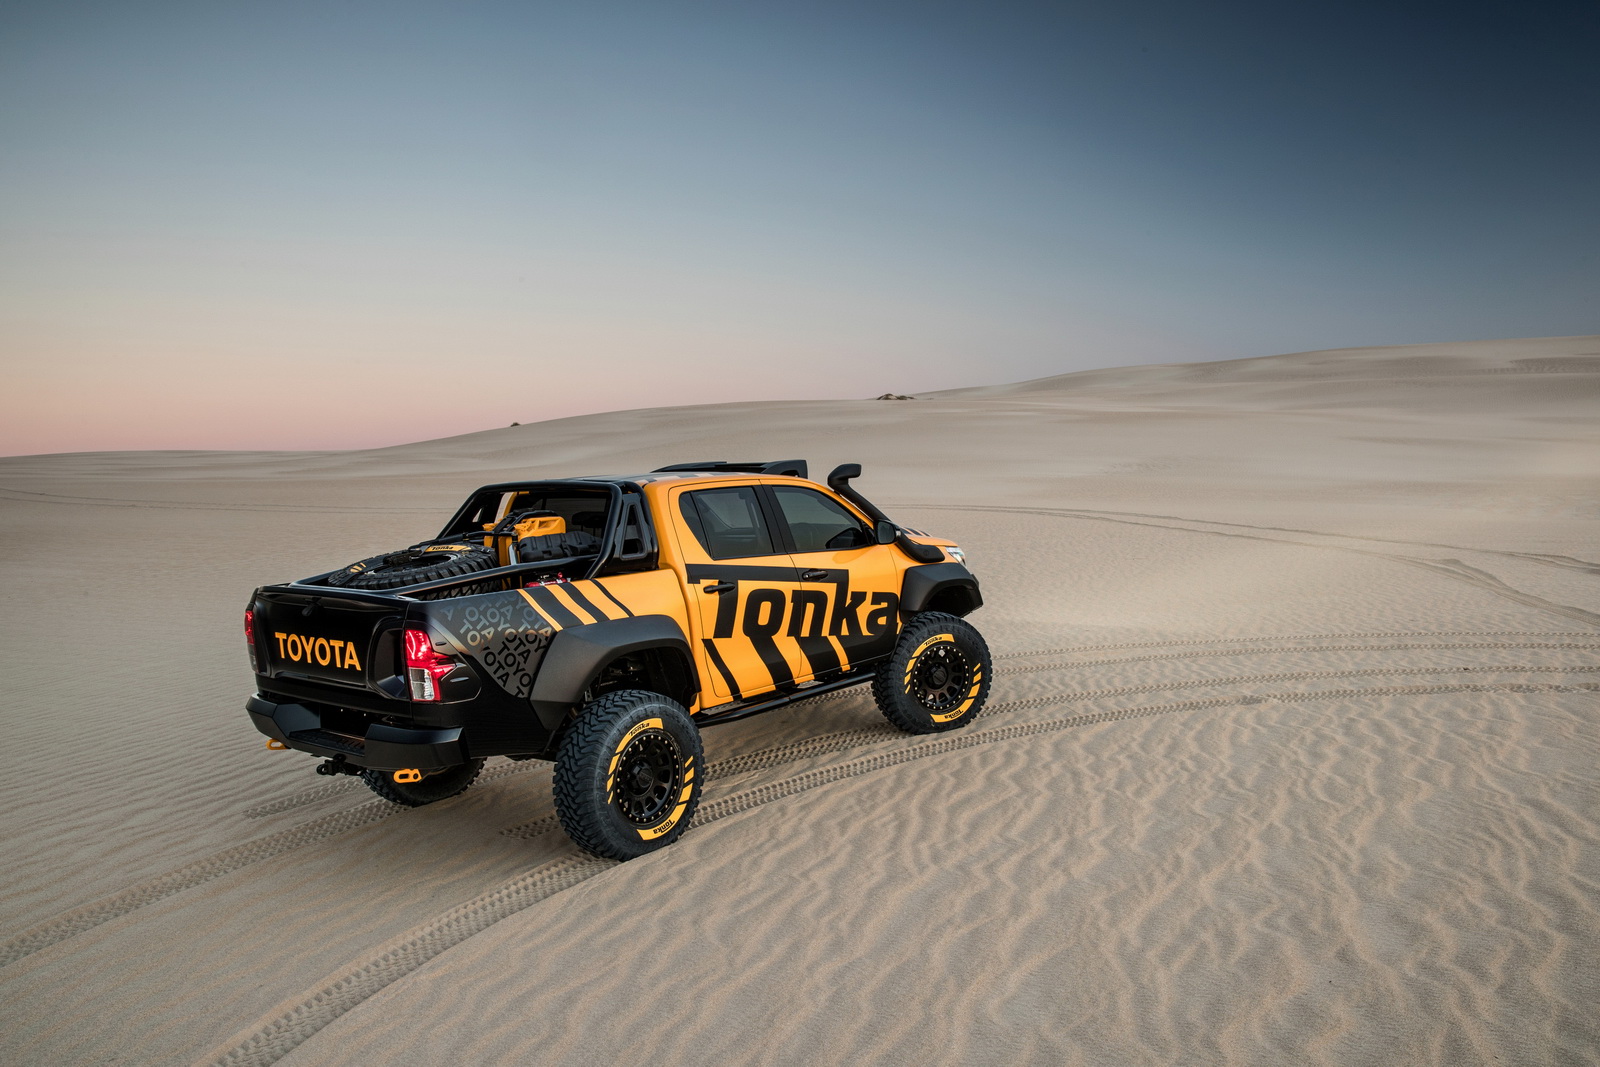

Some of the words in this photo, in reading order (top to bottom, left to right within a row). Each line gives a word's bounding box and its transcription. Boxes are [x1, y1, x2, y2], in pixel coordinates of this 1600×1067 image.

[686, 564, 899, 640] Tonka
[275, 631, 362, 671] TOYOTA
[628, 722, 650, 736] Tonka
[653, 818, 676, 834] Tonka
